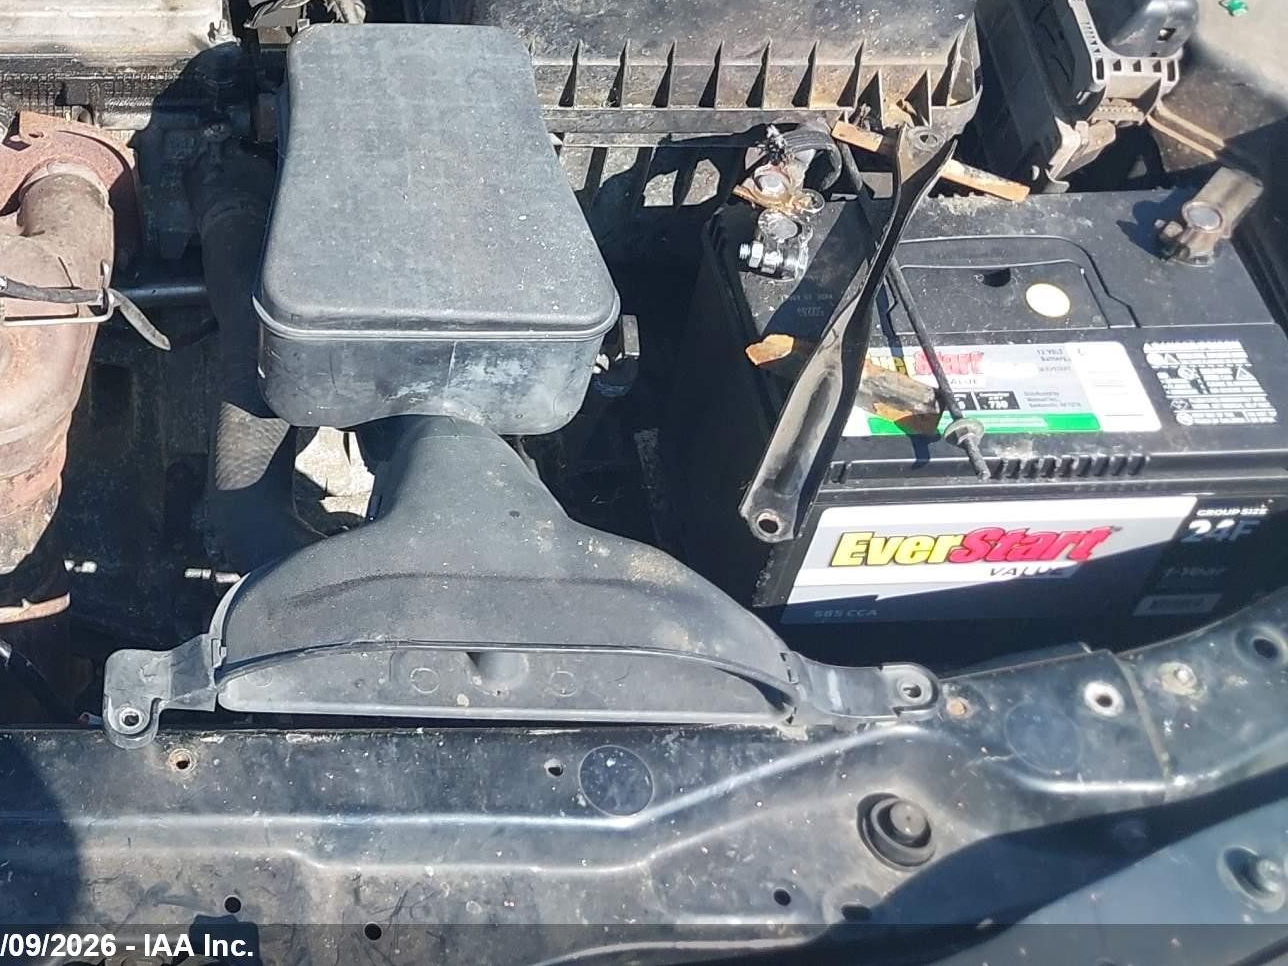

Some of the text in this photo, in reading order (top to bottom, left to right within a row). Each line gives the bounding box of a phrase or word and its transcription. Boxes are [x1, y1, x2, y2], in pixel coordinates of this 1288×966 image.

[1196, 507, 1269, 517] GROUP SIZE
[1180, 518, 1261, 543] 24F
[828, 526, 1113, 567] EverStart
[846, 609, 878, 618] CCA
